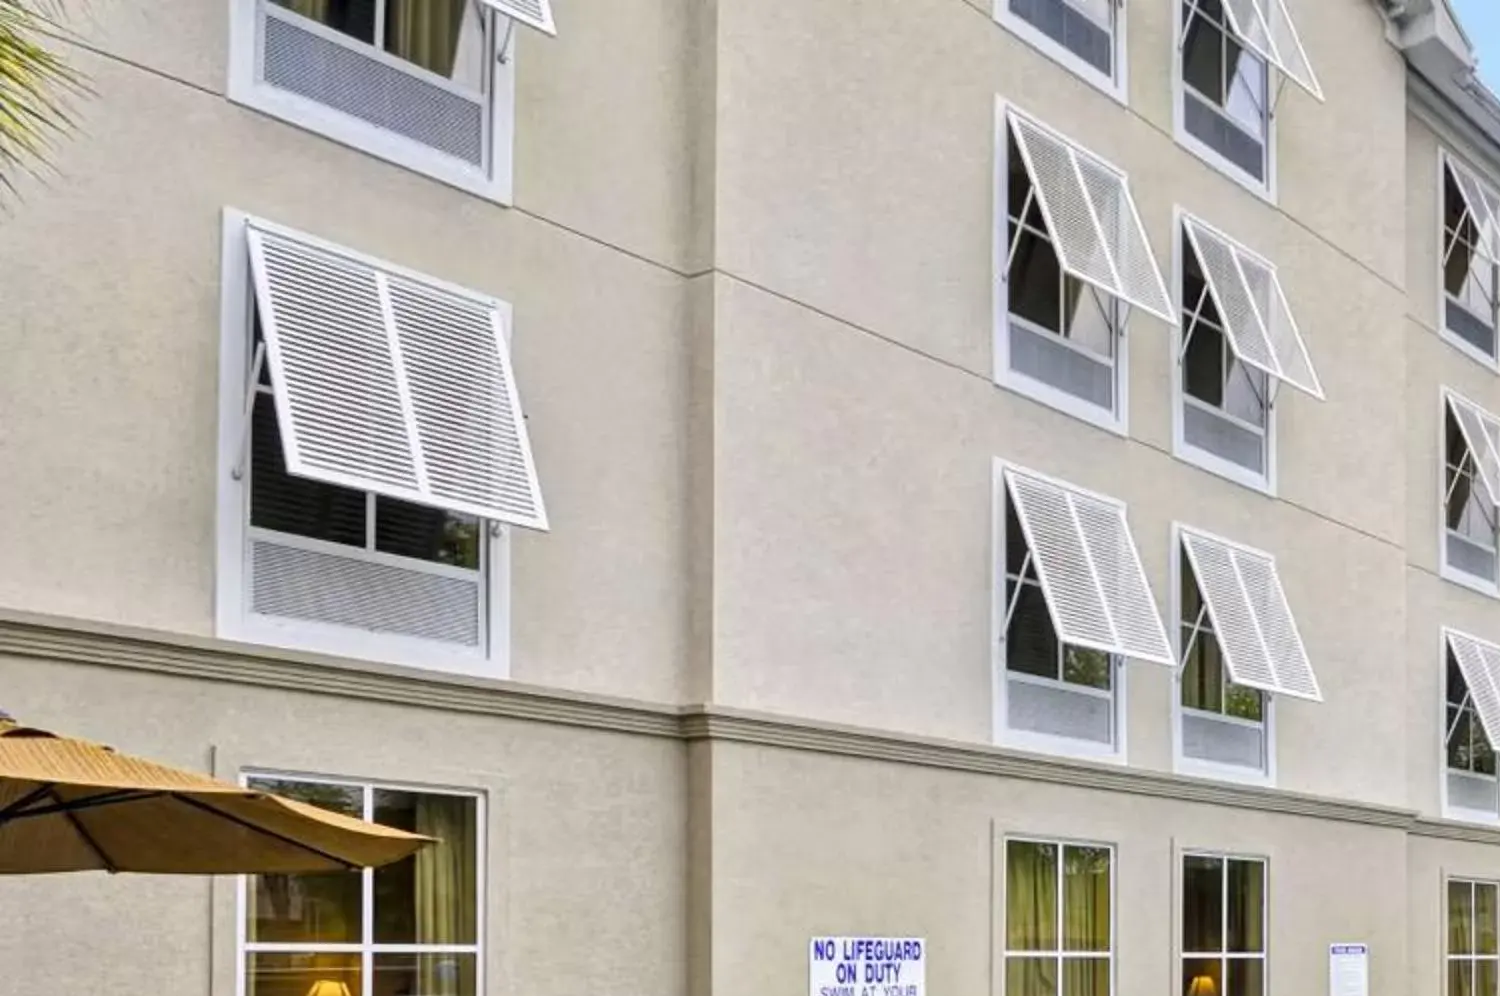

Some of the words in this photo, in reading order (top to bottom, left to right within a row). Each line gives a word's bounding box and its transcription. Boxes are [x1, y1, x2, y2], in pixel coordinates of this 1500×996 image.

[814, 940, 835, 961] NO
[843, 940, 921, 961] LIFEGUARD
[836, 963, 857, 984] ON
[865, 963, 901, 983] DUTY
